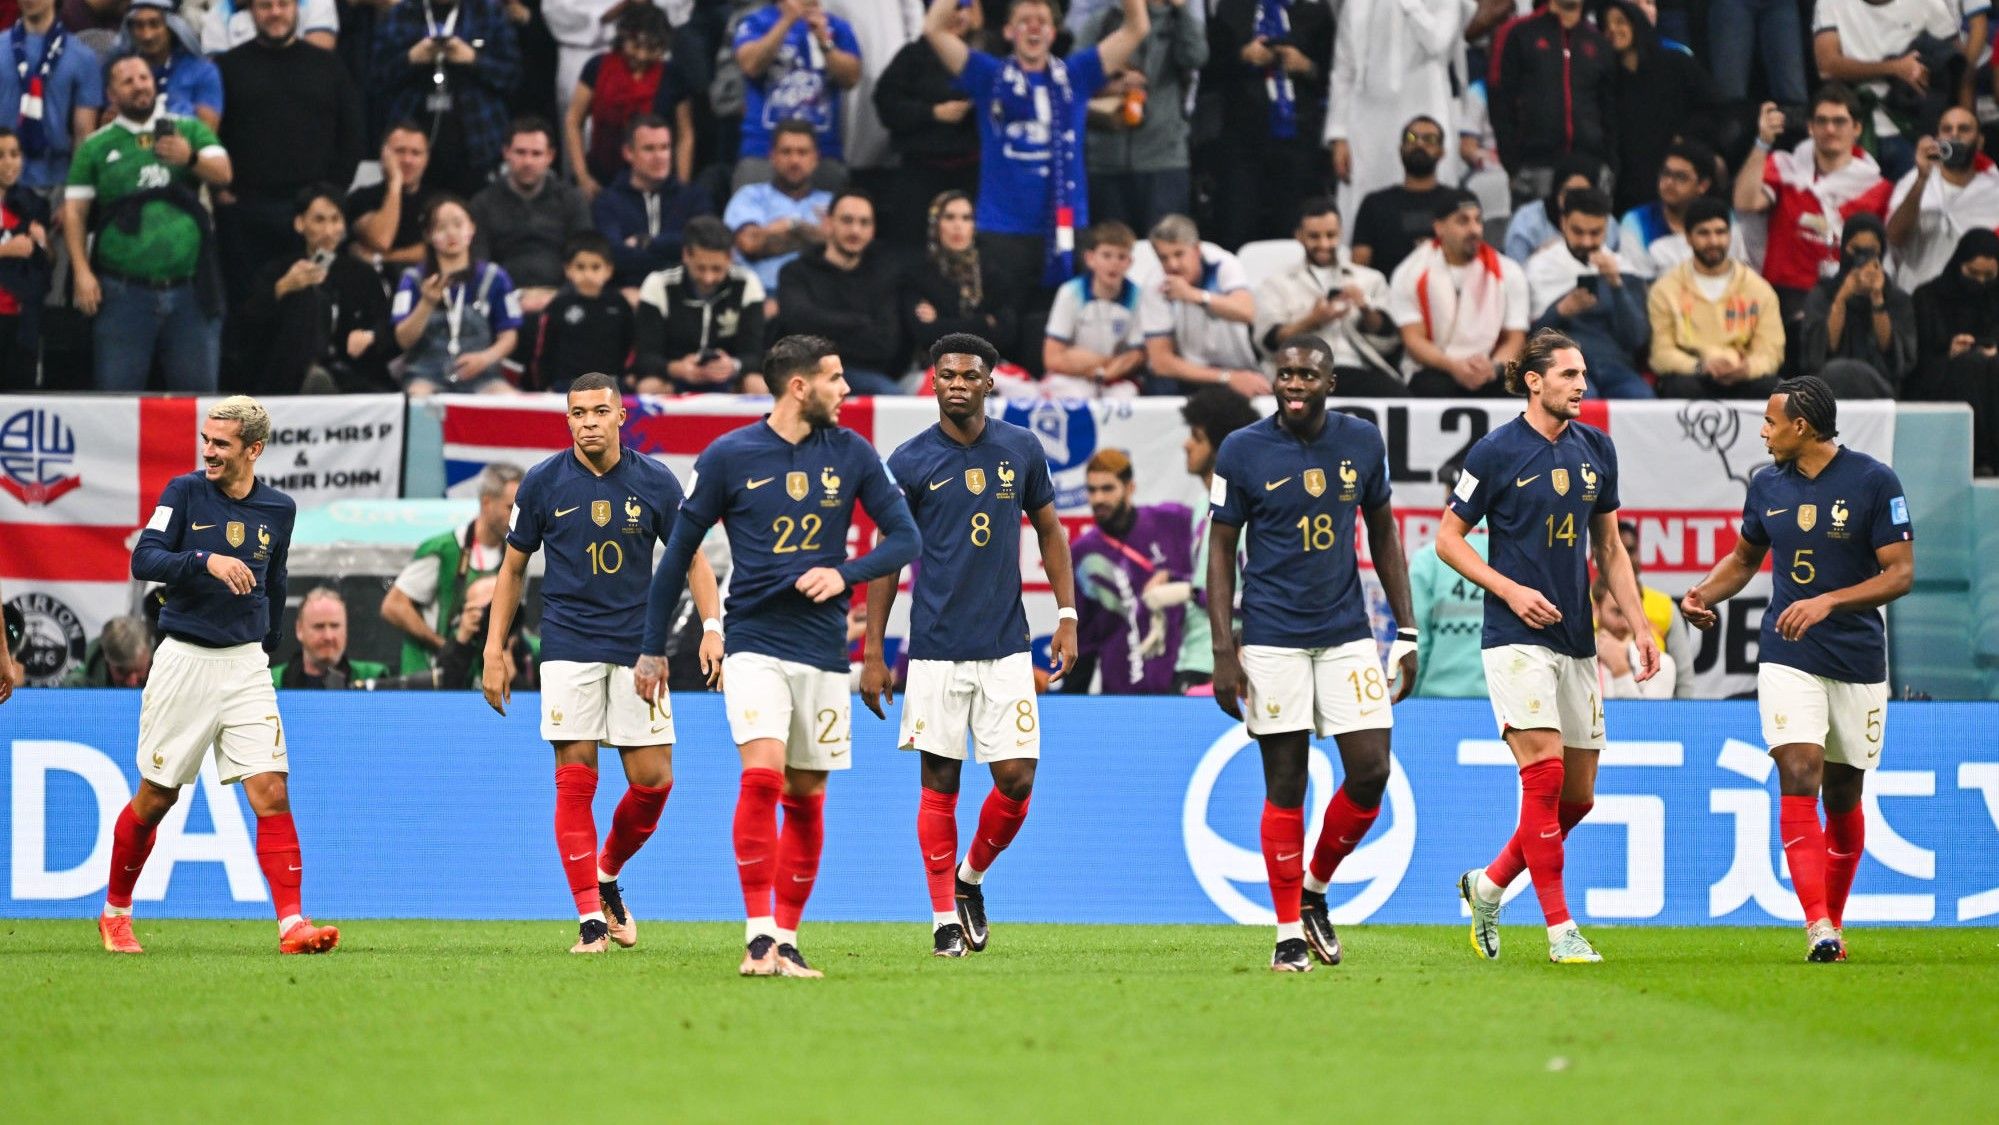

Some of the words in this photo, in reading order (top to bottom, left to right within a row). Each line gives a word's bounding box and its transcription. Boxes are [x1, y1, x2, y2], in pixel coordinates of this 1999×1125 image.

[324, 425, 373, 442] MRS
[323, 469, 380, 489] JOHN
[773, 513, 822, 553] 22
[971, 512, 991, 547] 8
[1296, 513, 1335, 552] 18
[1545, 512, 1577, 548] 14
[585, 540, 623, 575] 10
[1790, 549, 1816, 585] 5
[1347, 667, 1384, 703] 18
[266, 705, 281, 747] 7
[1016, 700, 1035, 733] 8
[1865, 707, 1881, 743] 5
[11, 740, 269, 902] DA
